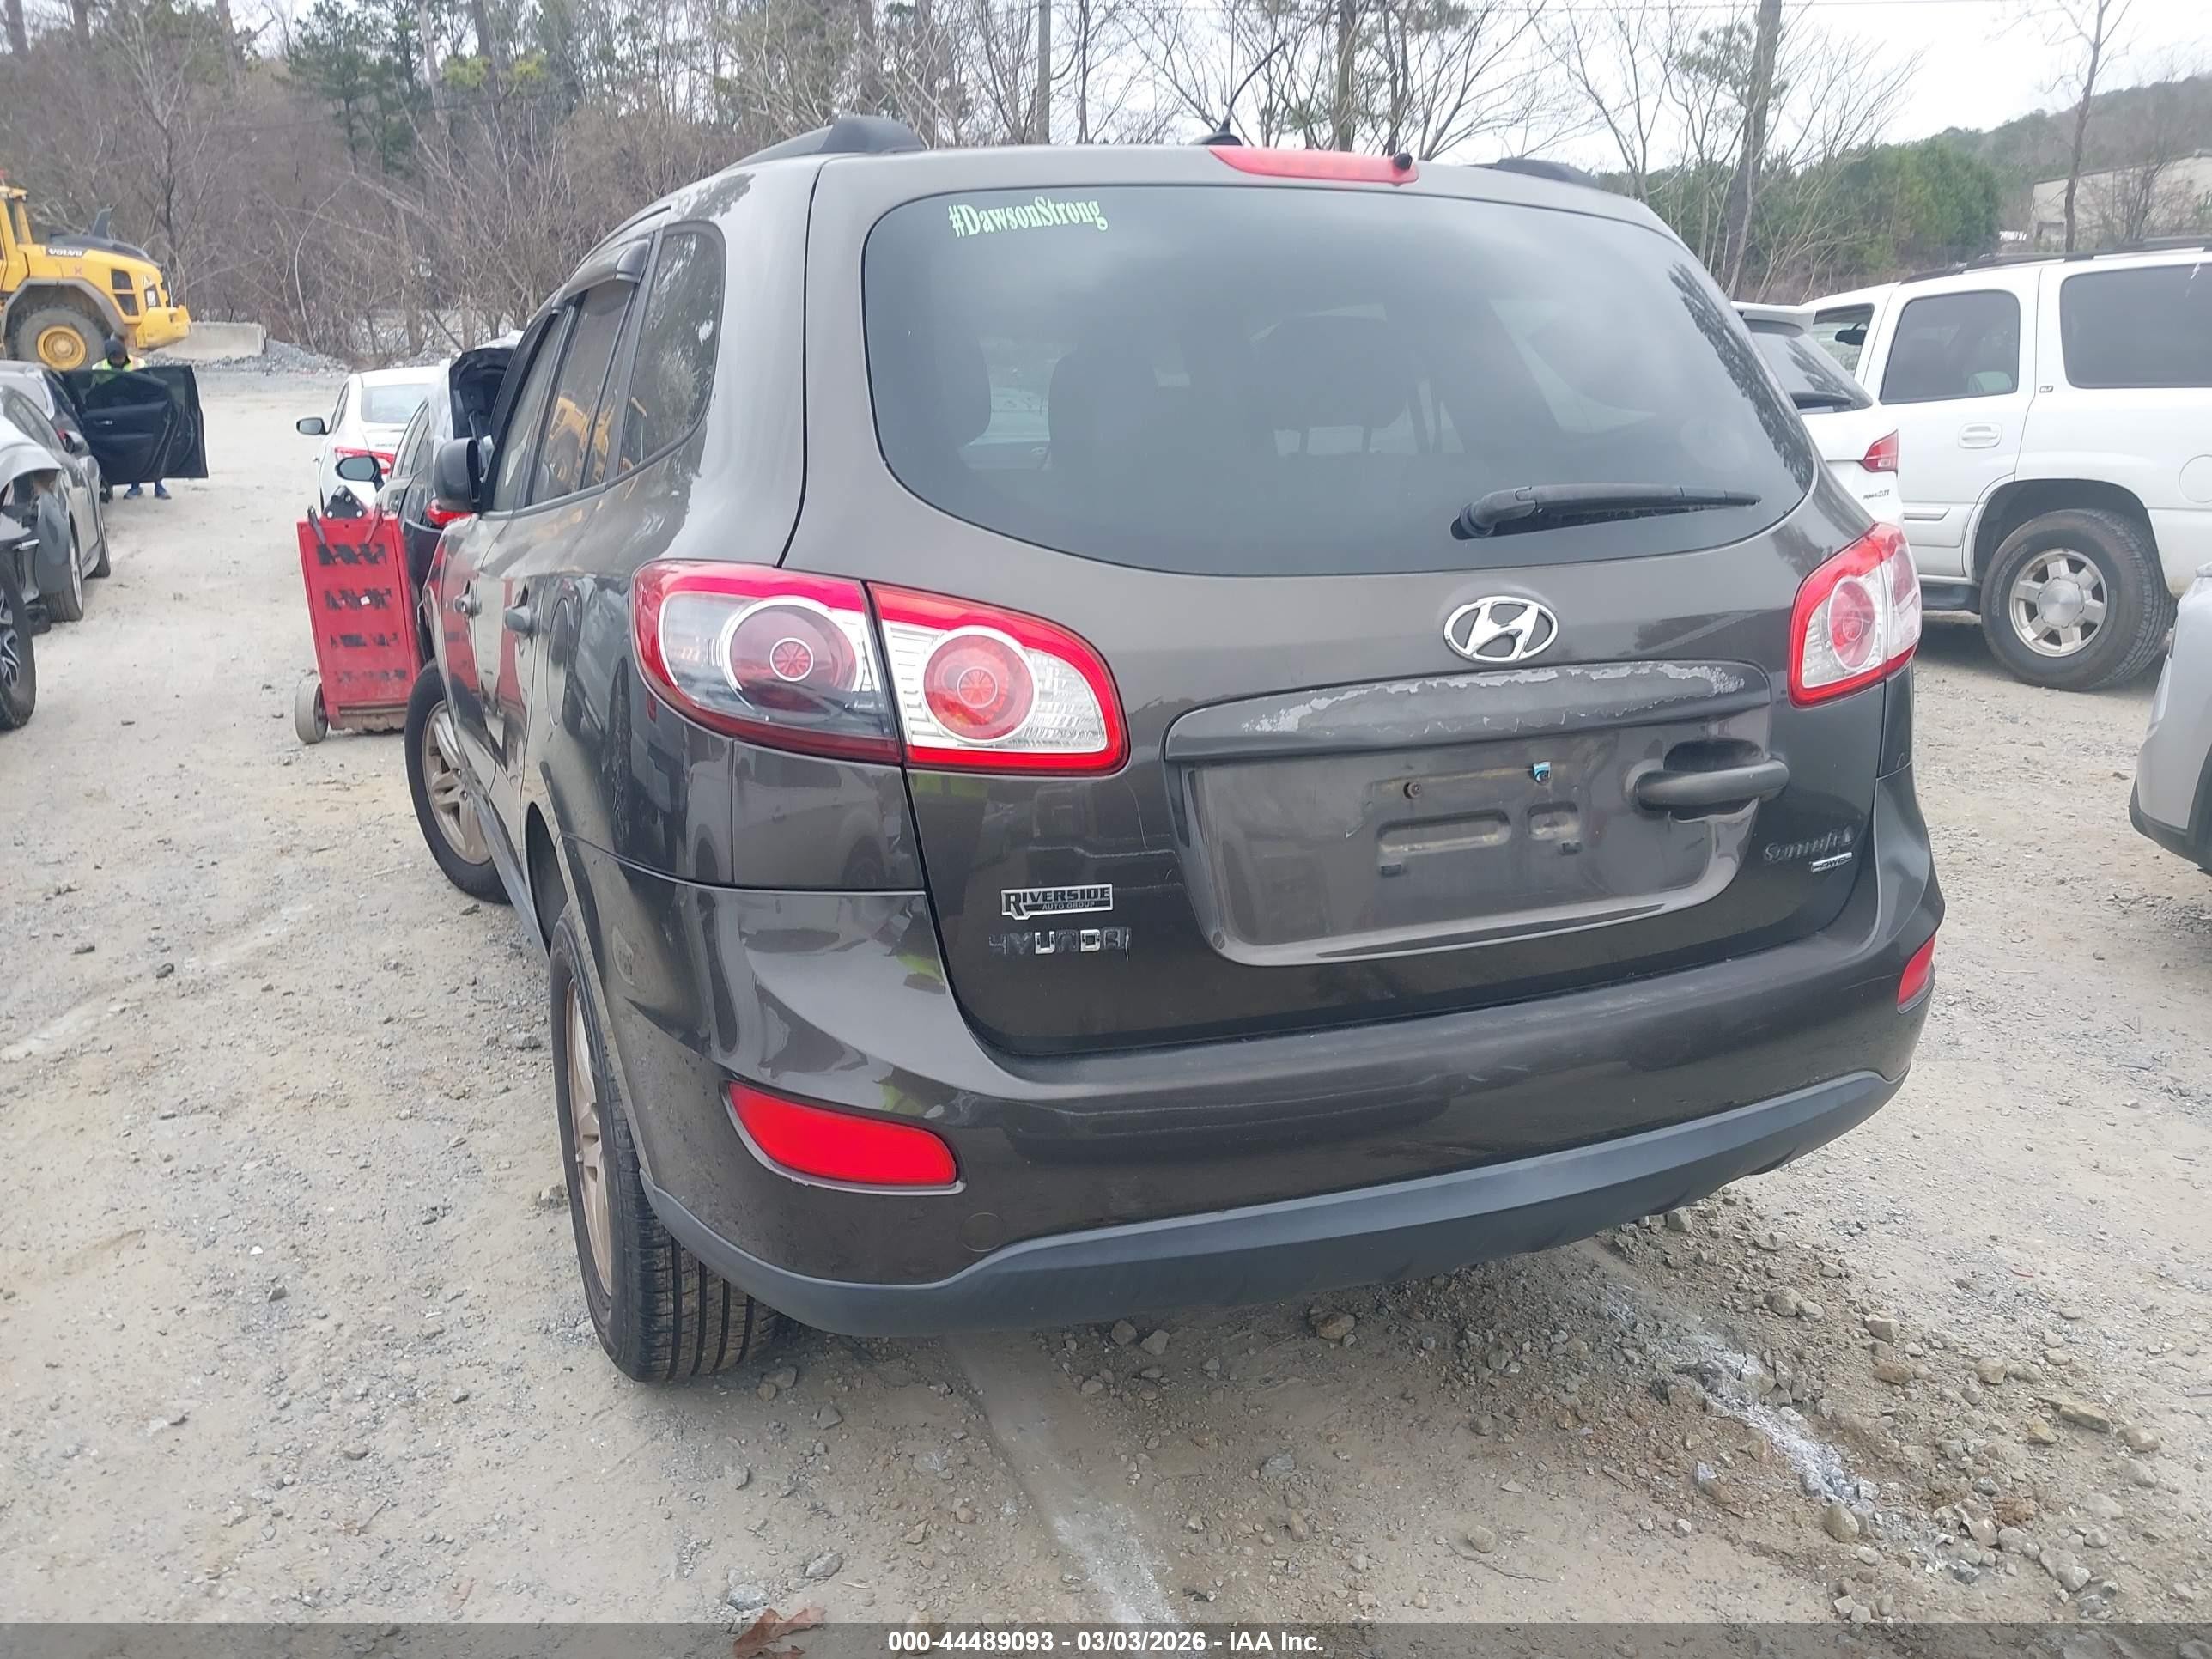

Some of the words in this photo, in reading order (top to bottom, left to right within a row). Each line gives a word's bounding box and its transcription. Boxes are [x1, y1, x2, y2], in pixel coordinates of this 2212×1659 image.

[948, 196, 1108, 238] #DawsonStrong
[48, 248, 83, 257] VOLVO
[1005, 887, 1110, 916] RIVERSIDE
